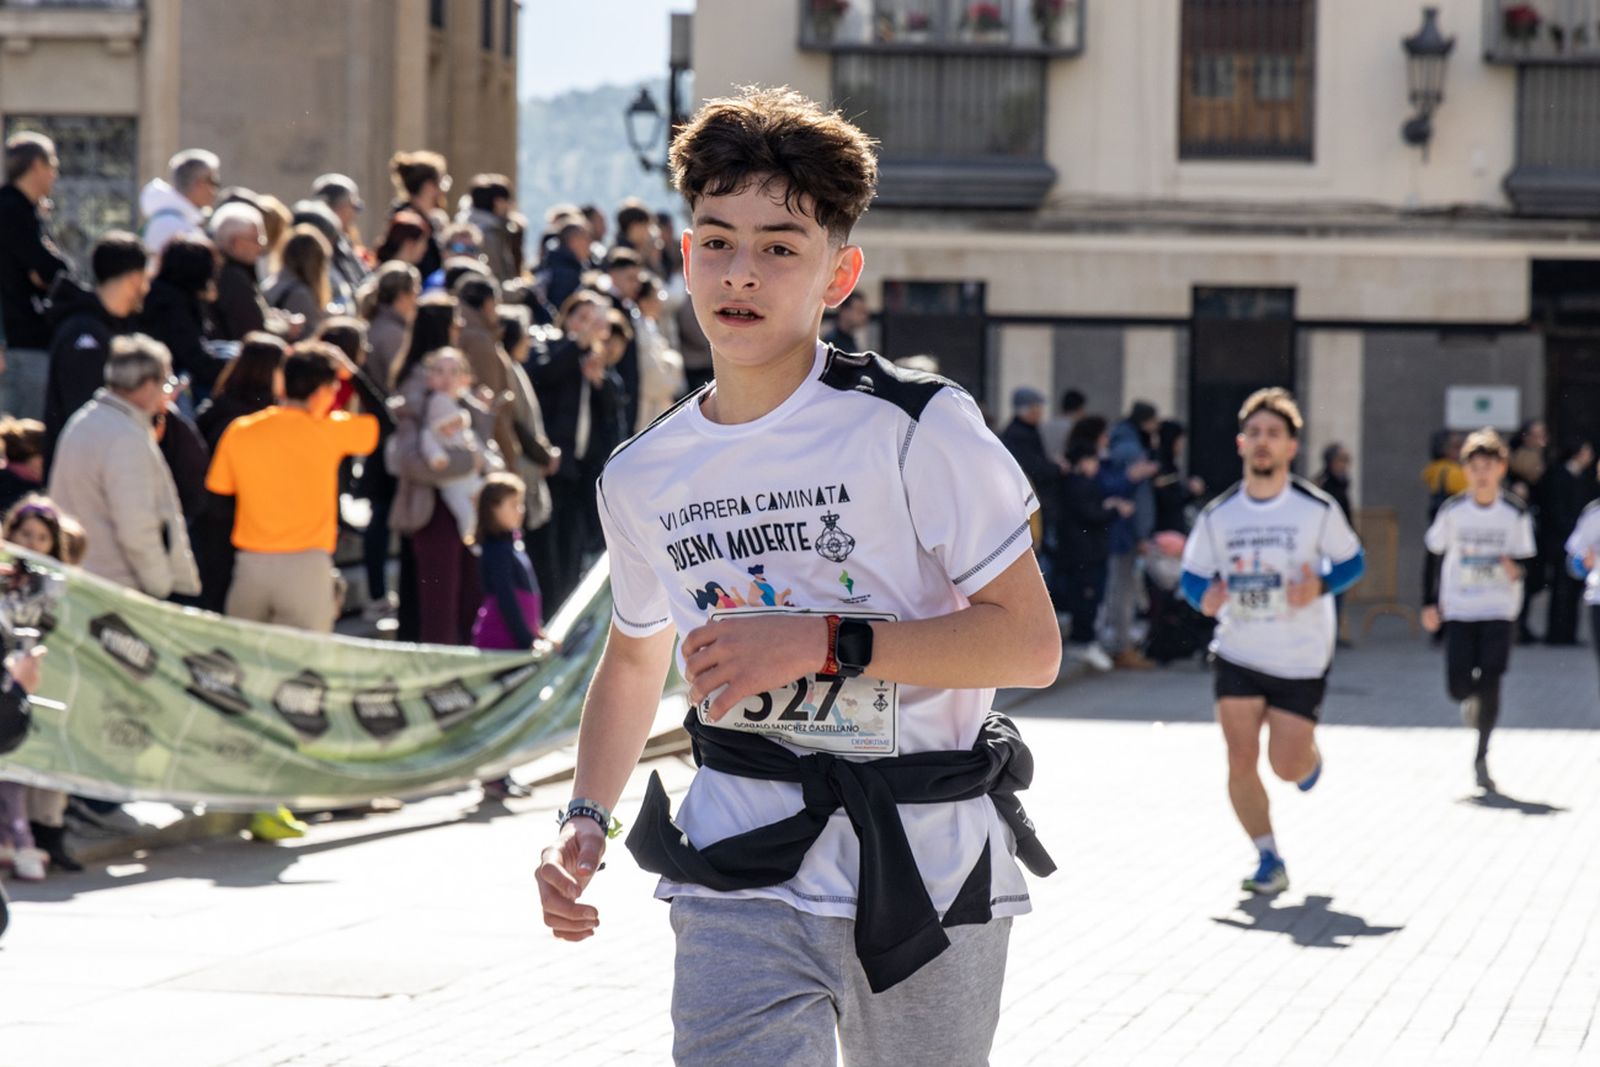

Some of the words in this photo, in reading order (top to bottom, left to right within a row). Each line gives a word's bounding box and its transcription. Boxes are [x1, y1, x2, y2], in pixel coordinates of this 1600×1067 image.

[659, 511, 678, 531] VI
[755, 483, 851, 511] CAMINATA
[726, 522, 812, 560] MUERTE
[771, 723, 807, 732] SANCHEZ
[808, 724, 860, 733] CASTELLANO
